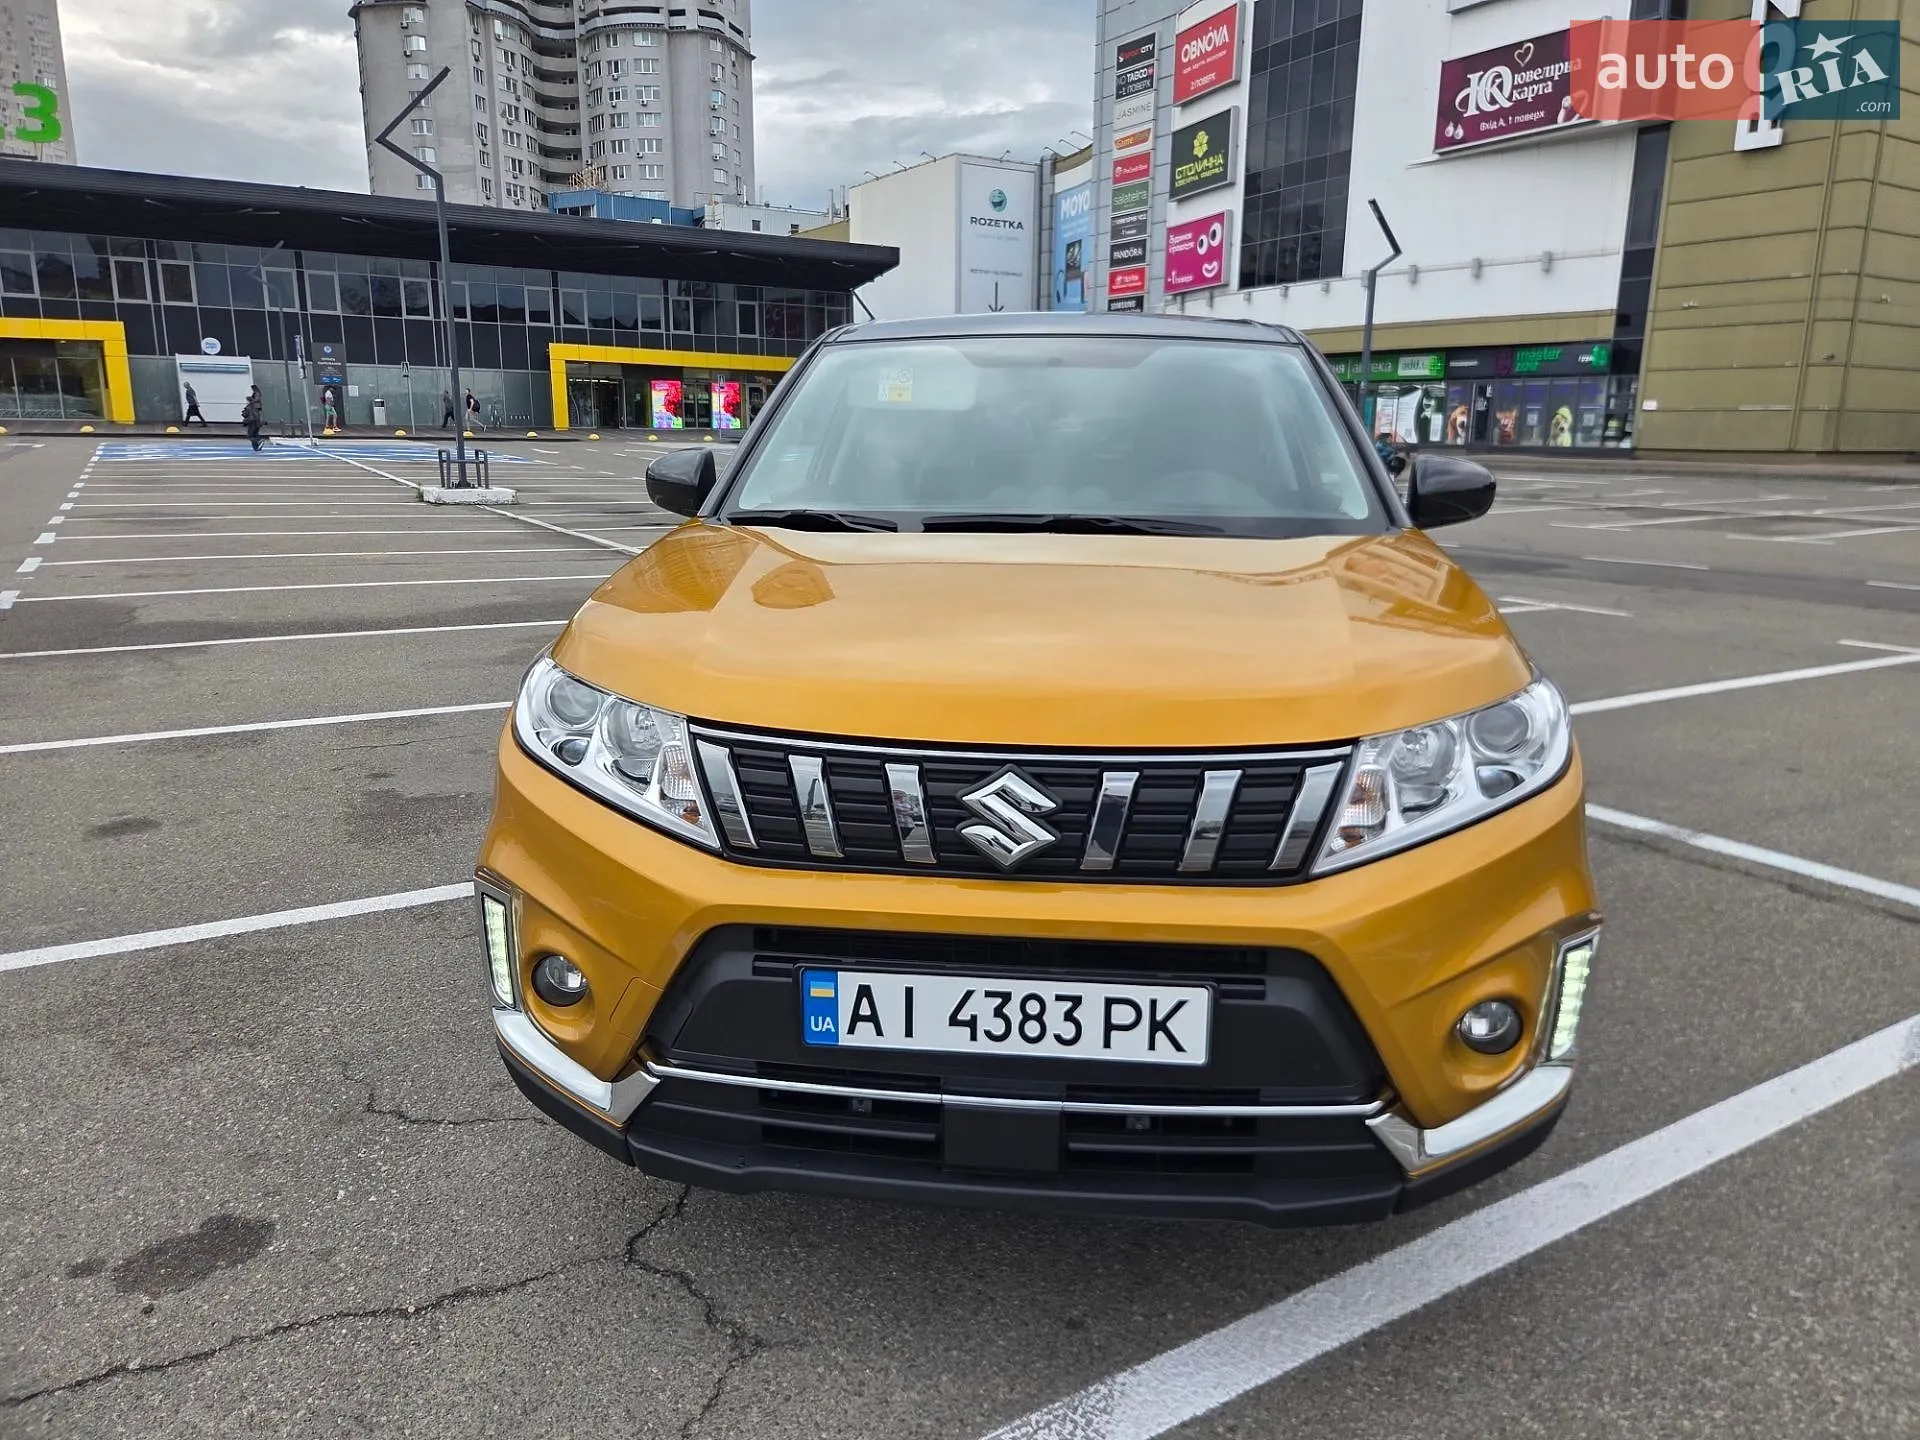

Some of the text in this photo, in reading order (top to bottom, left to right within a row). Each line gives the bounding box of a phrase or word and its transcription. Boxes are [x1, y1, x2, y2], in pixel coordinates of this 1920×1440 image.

[1511, 80, 1553, 102] карта
[1115, 102, 1153, 120] JASMINE
[1060, 189, 1091, 220] MOYO
[969, 216, 1025, 230] ROZETKA
[1113, 247, 1144, 260] PANDORA
[810, 1015, 836, 1033] UA
[948, 989, 1083, 1047] 4383
[1102, 996, 1190, 1053] PK
